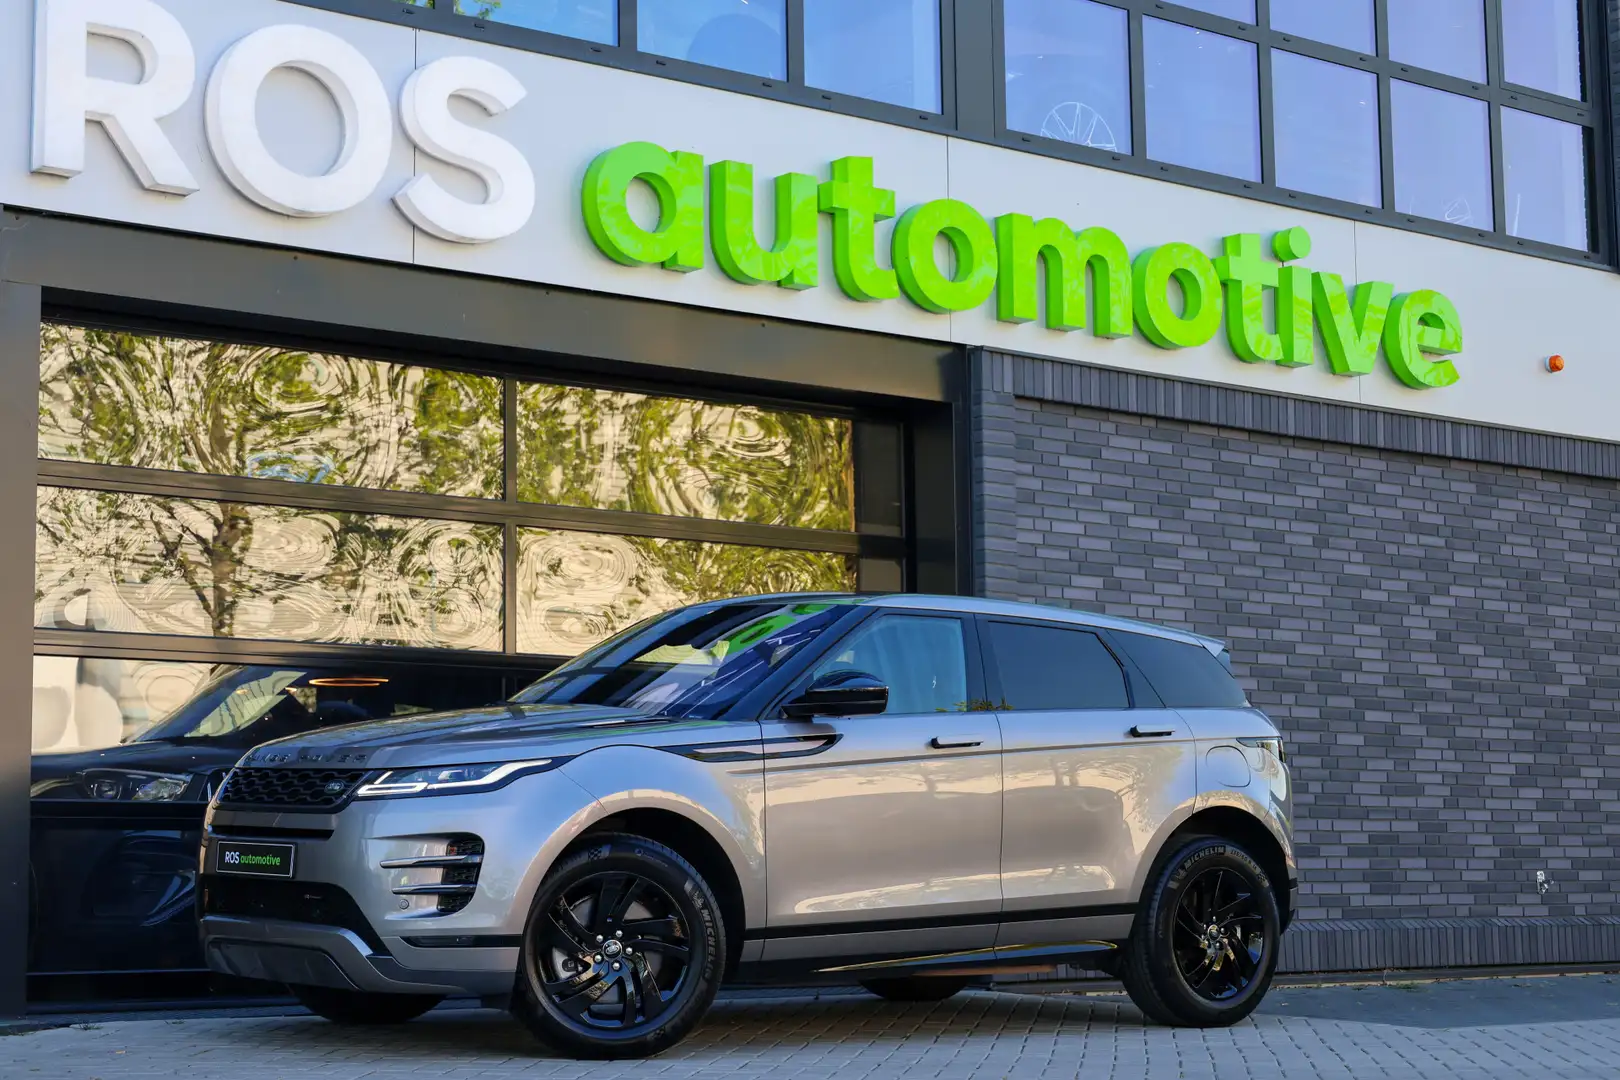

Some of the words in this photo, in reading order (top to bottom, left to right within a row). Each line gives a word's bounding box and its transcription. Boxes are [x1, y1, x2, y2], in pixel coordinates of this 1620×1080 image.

[30, 0, 536, 245] ROS
[581, 141, 1463, 390] automotive
[224, 851, 240, 864] ROS
[240, 854, 281, 866] automotive
[1183, 846, 1225, 870] MICHELIN
